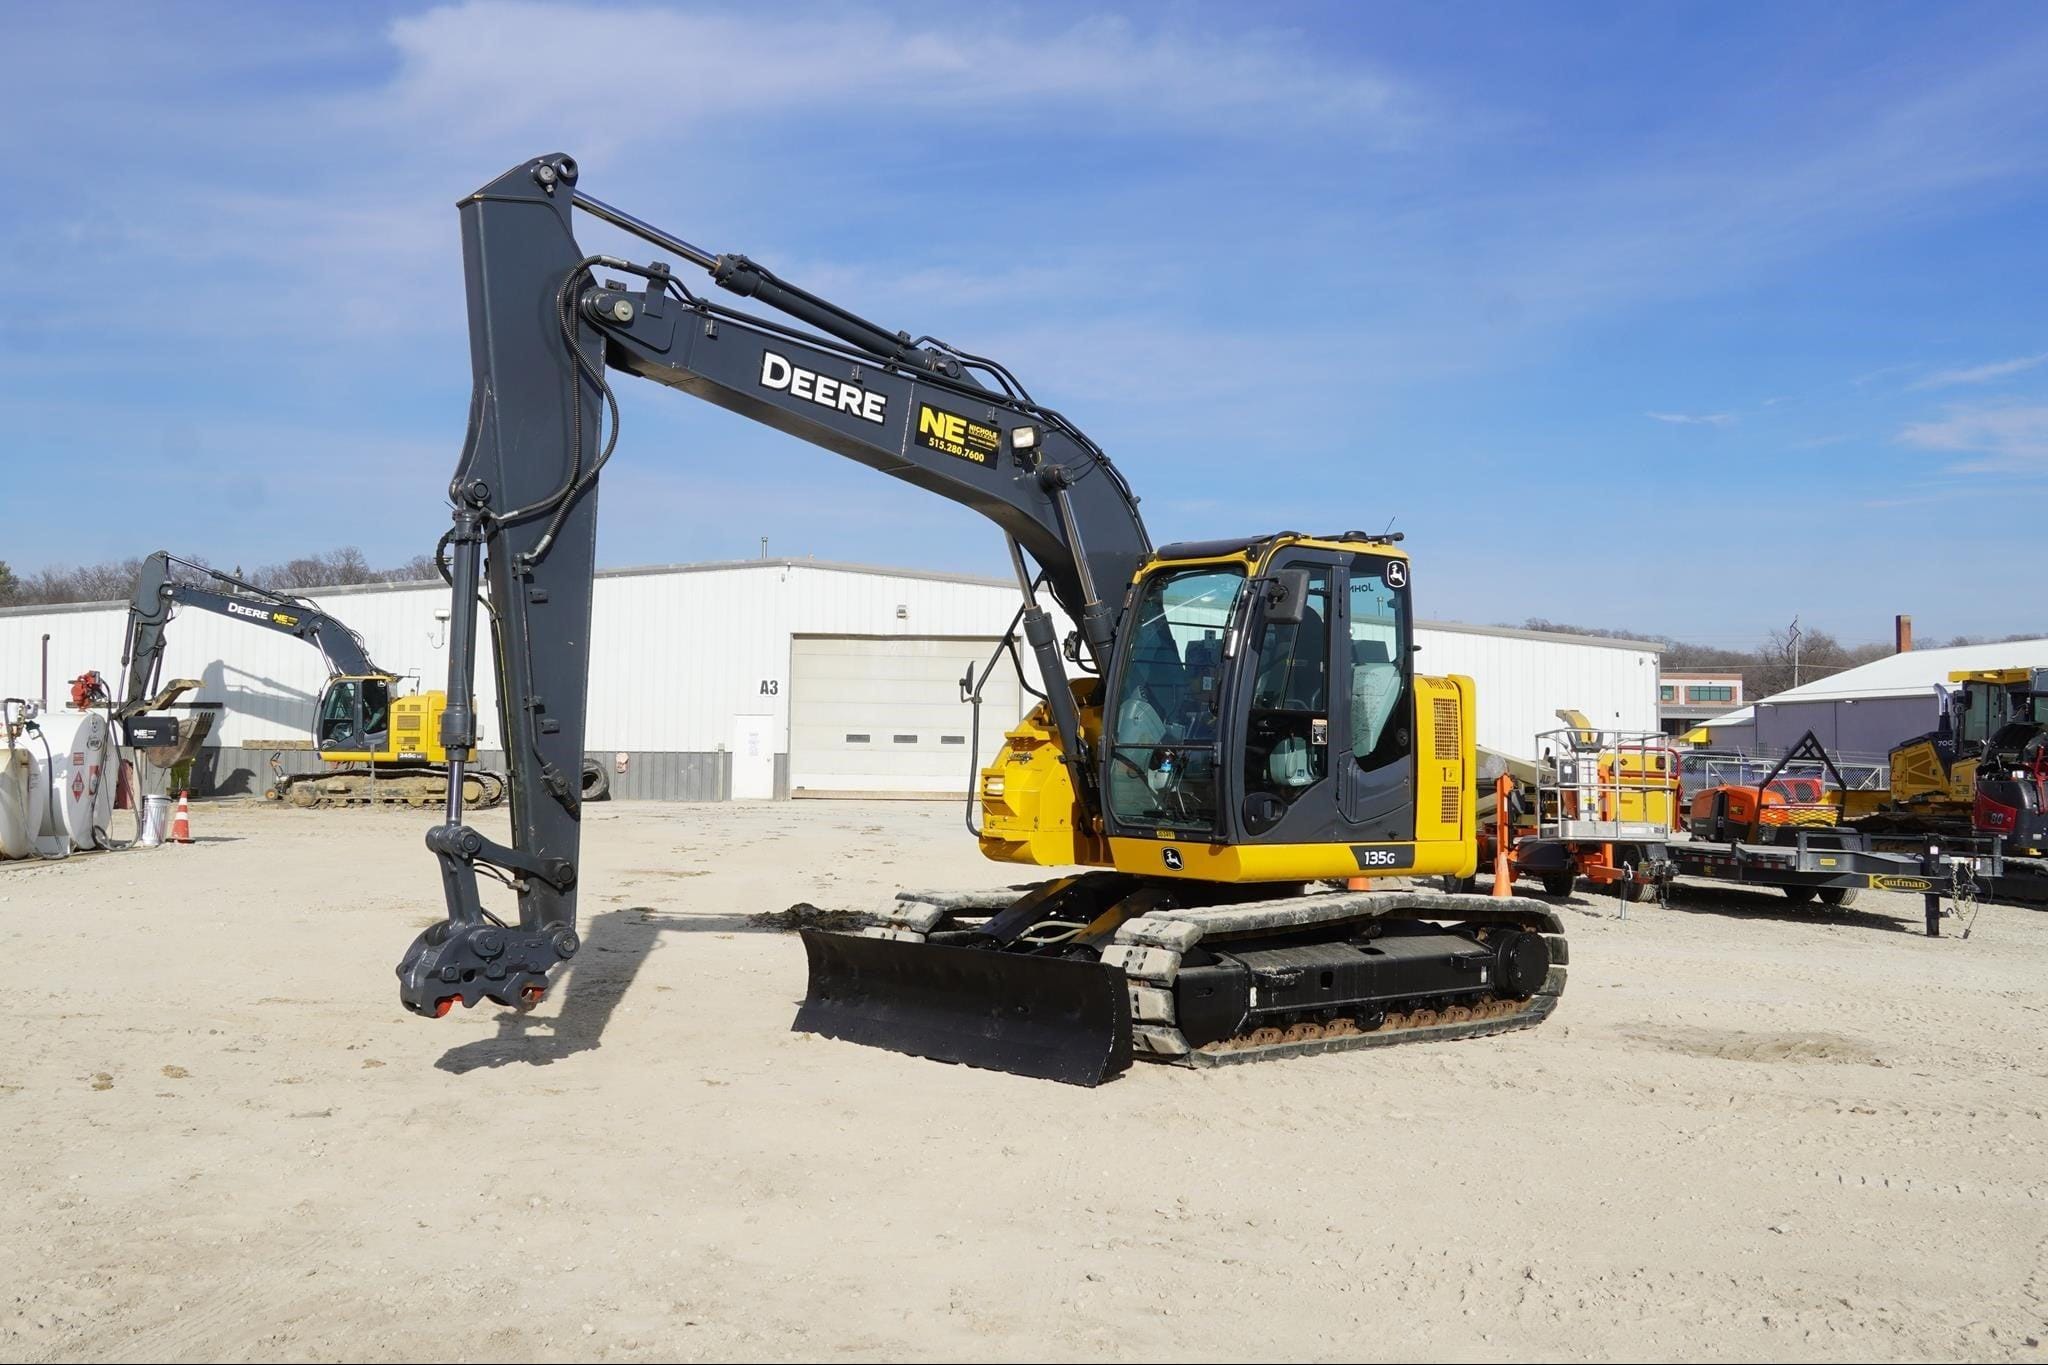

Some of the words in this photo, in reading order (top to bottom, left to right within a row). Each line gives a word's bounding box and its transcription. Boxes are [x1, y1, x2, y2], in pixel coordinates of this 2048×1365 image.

[762, 352, 886, 424] DEERE
[920, 406, 967, 445] NE
[928, 437, 985, 462] 515.280.7600
[227, 602, 270, 620] DEERE
[273, 613, 288, 623] NE
[759, 679, 779, 695] A3
[1364, 851, 1396, 865] 135G
[1868, 874, 1926, 891] Kaufman
